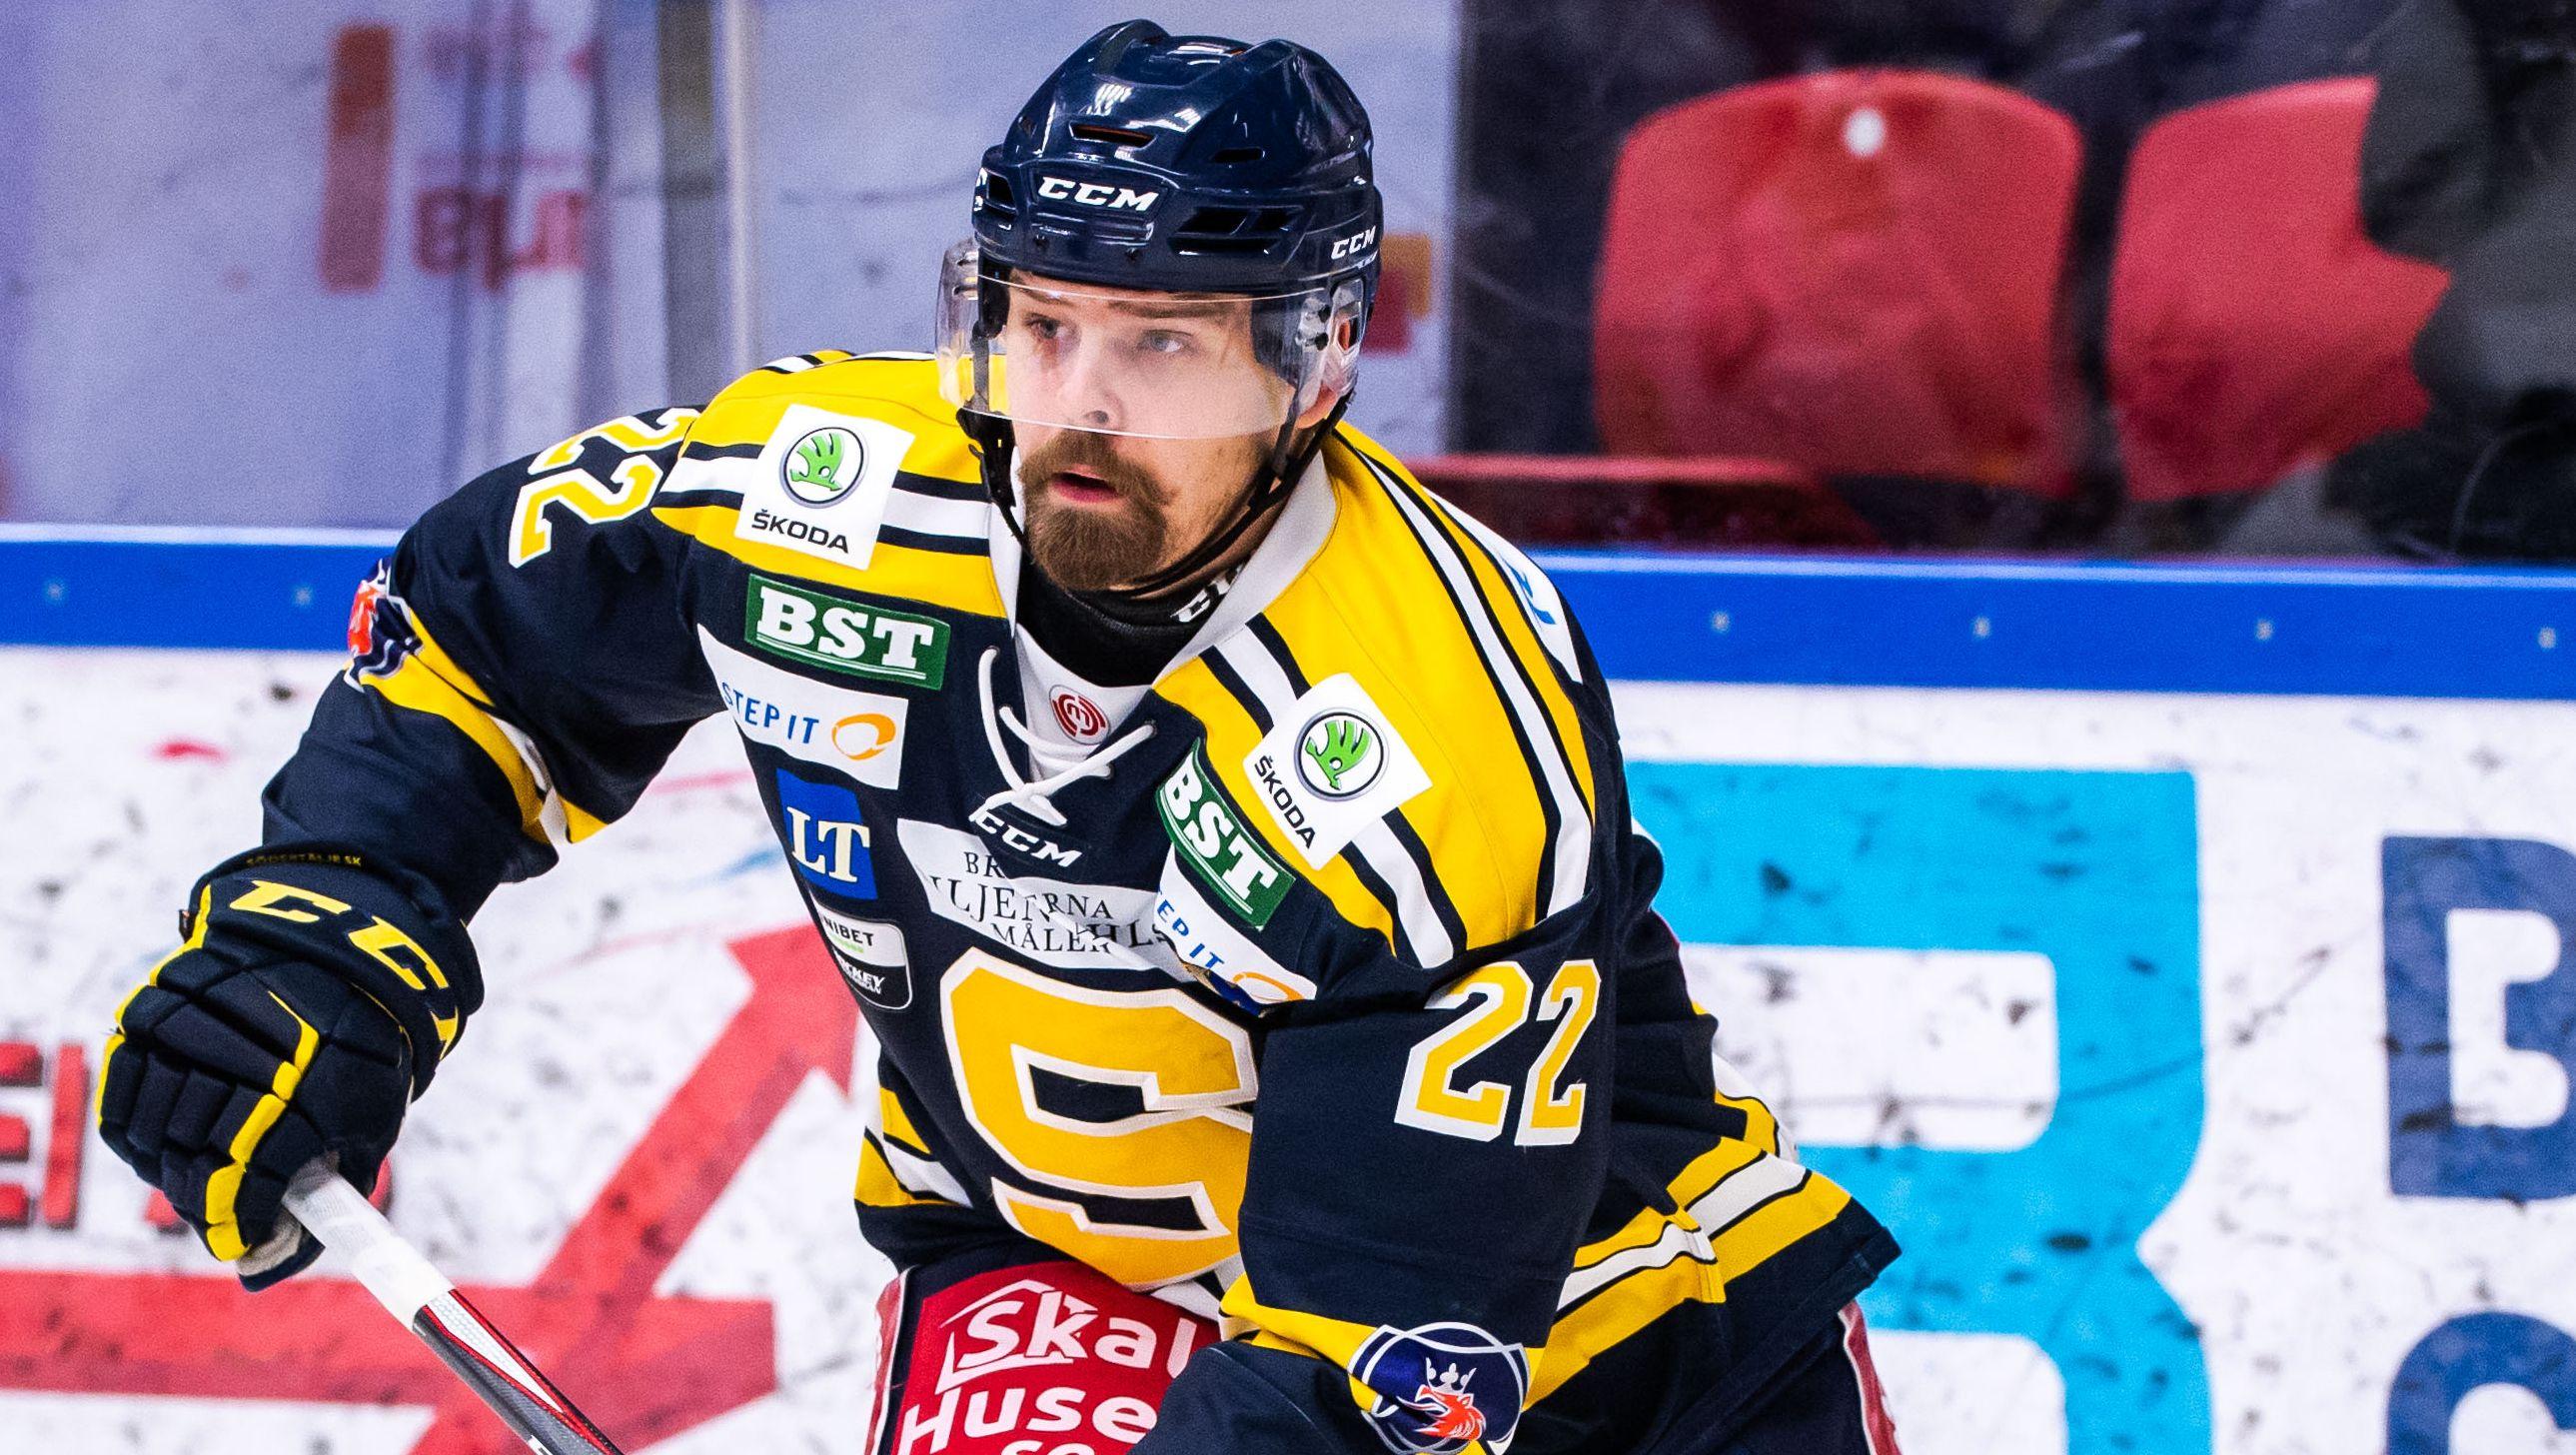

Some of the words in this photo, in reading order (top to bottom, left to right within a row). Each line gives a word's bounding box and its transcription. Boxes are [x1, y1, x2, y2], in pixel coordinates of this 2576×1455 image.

[1038, 176, 1160, 212] CCM
[1331, 225, 1376, 260] CCM
[509, 408, 701, 569] 22
[751, 509, 849, 555] ŠKODA
[757, 586, 934, 671] BST
[721, 682, 780, 728] STEP
[786, 716, 819, 744] IT
[974, 810, 1082, 867] CCM
[1163, 749, 1279, 900] BST
[1254, 754, 1316, 849] ŠKODA
[786, 805, 870, 883] LT
[230, 879, 459, 1029] CC
[1189, 942, 1225, 969] IT
[1394, 958, 1602, 1147] 22
